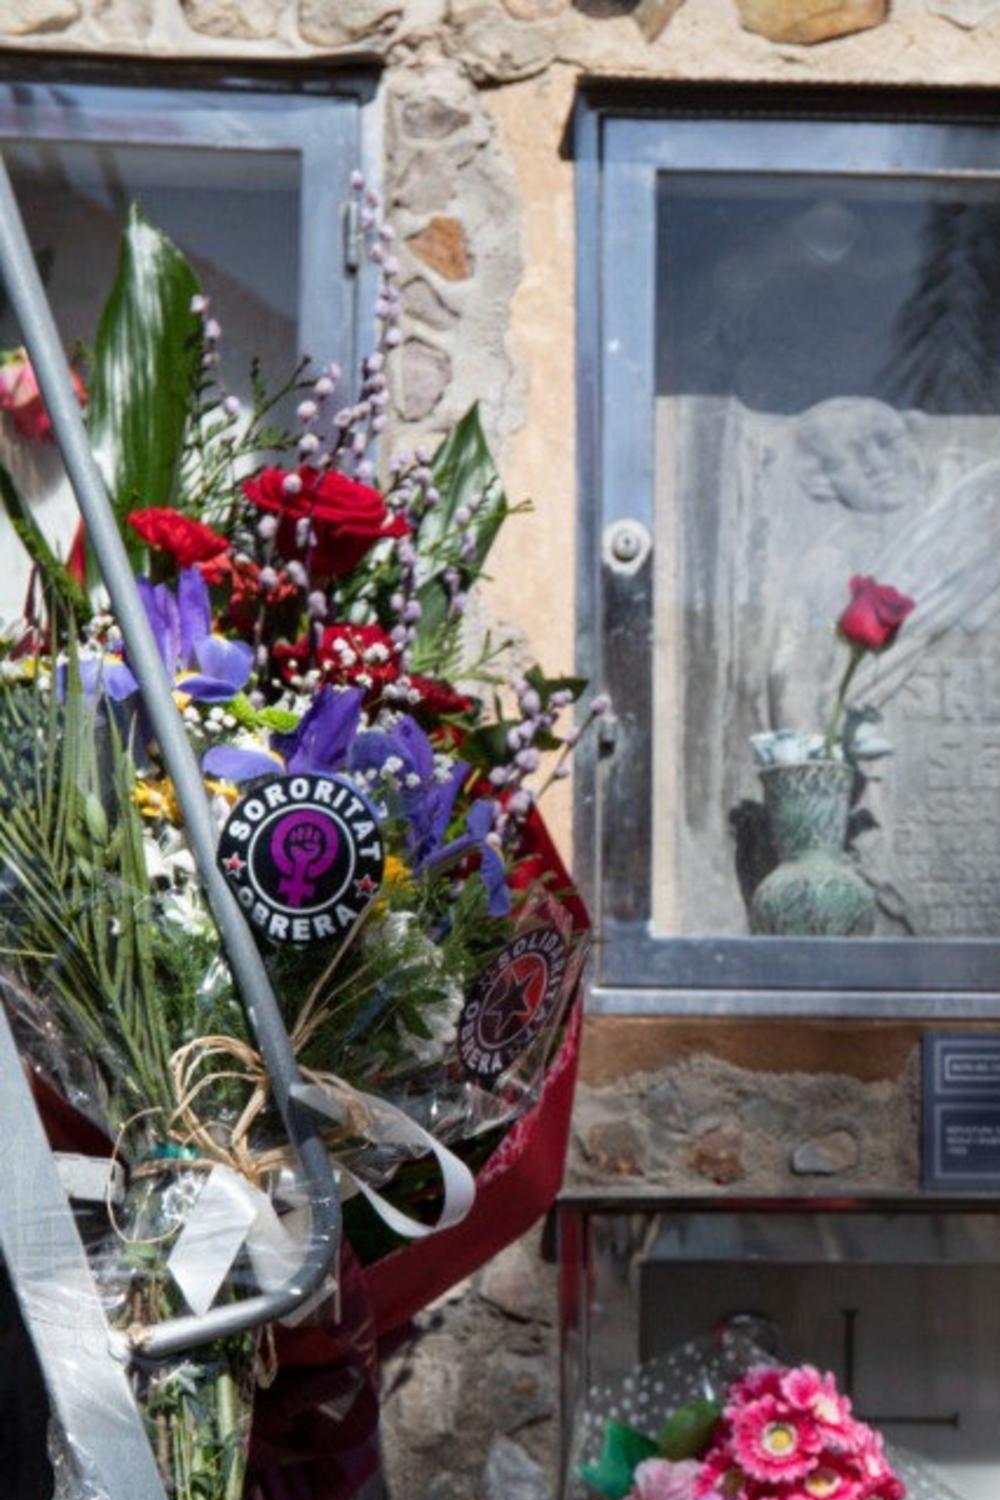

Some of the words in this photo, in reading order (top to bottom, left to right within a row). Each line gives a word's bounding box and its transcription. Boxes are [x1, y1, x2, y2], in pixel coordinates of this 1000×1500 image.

[228, 778, 381, 861] SORORITAT
[238, 885, 358, 941] OBRERA
[461, 1001, 503, 1075] OBRERA
